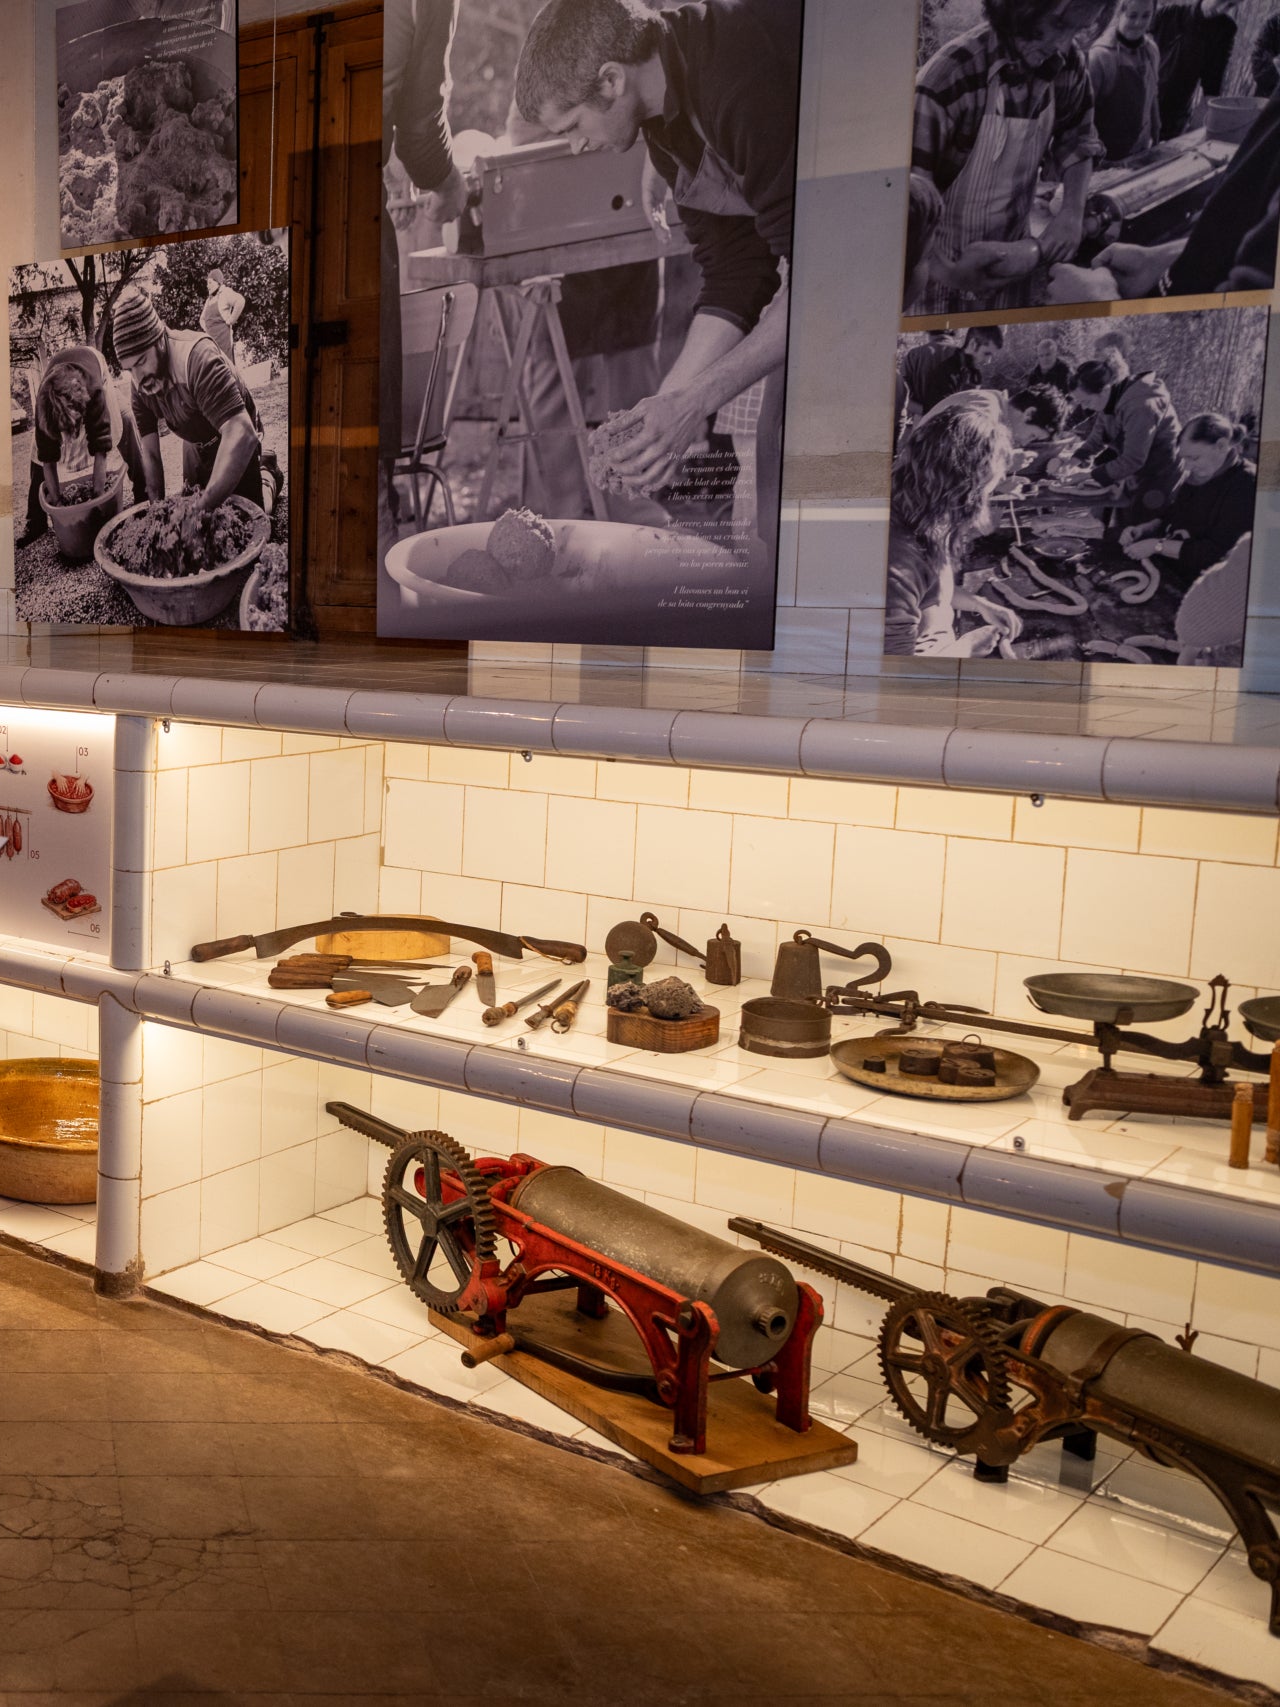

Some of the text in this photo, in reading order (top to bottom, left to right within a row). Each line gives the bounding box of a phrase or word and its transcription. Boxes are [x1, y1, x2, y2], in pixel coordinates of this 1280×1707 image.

[710, 477, 721, 486] de
[78, 746, 89, 757] 03
[30, 849, 40, 860] 05
[90, 923, 101, 933] 06
